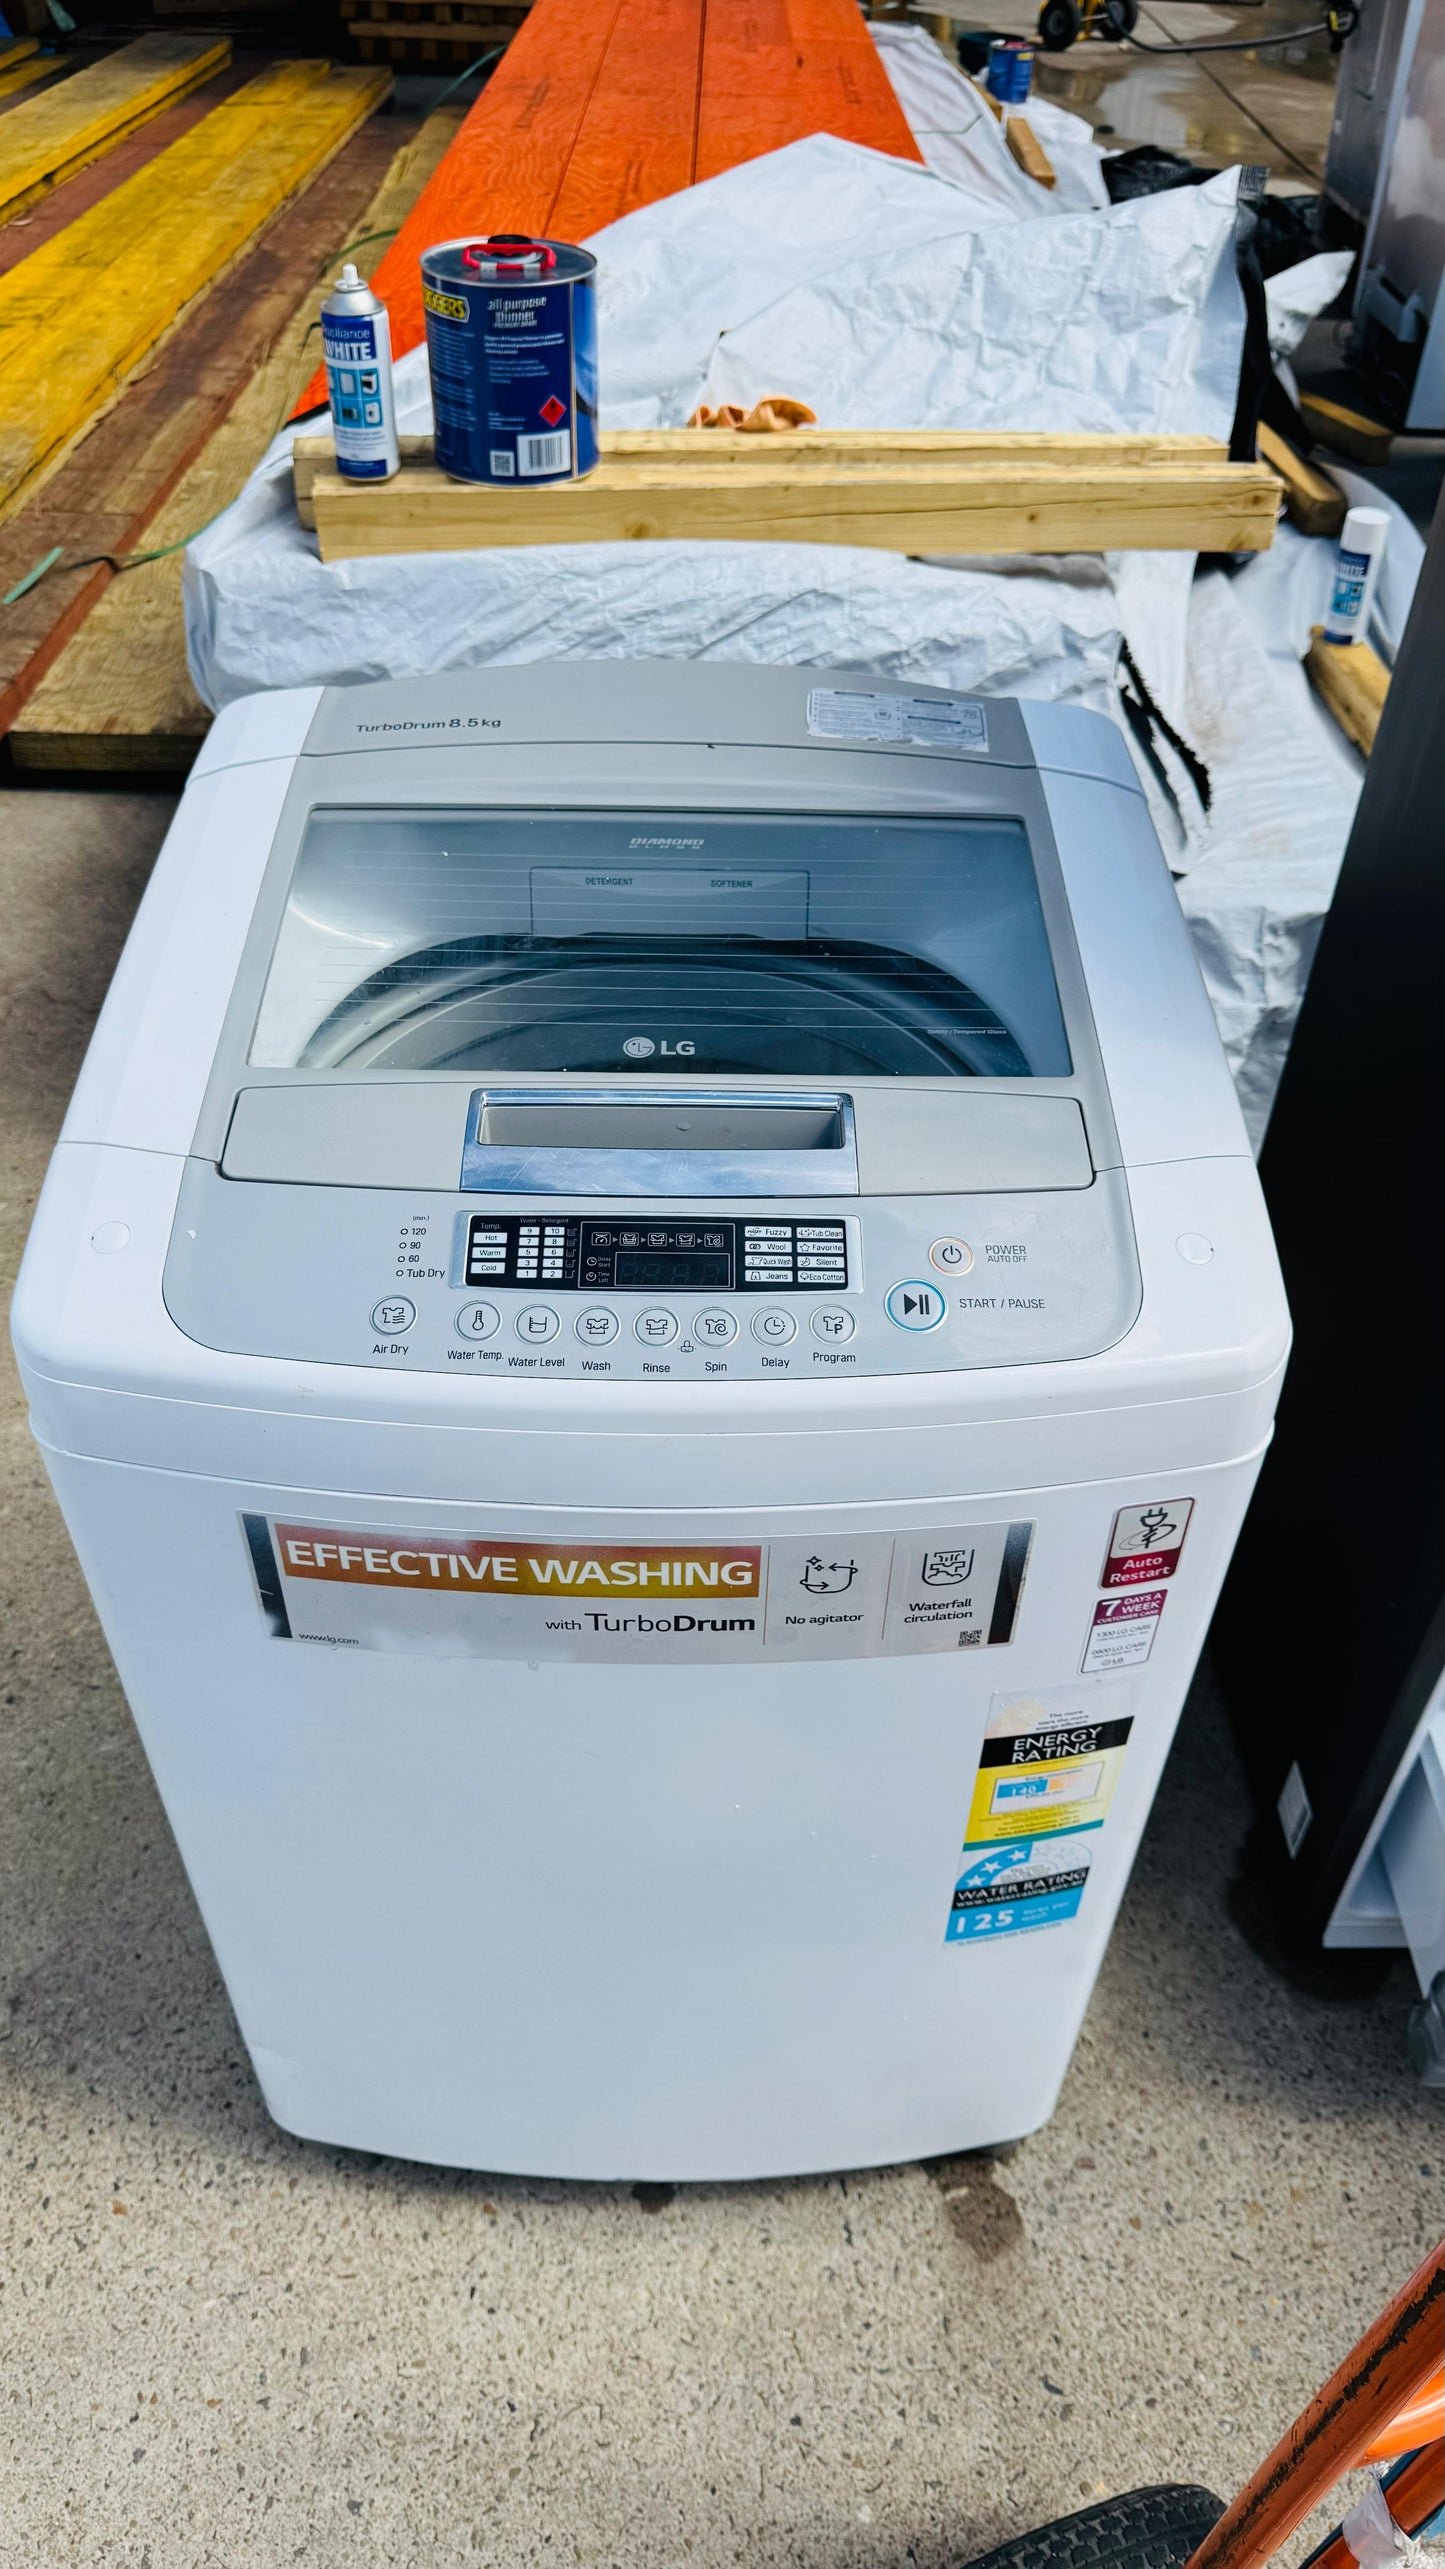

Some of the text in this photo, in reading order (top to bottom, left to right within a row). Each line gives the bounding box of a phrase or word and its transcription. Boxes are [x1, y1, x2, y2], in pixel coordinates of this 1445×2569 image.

[487, 296, 547, 312] all purpose
[325, 339, 373, 360] WHITE
[356, 721, 446, 733] TurboDrum
[630, 838, 704, 846] DIAMOND
[585, 877, 753, 889] DETERGENT SOFTENER
[661, 1041, 696, 1056] LG
[411, 1228, 427, 1236] 120
[480, 1222, 502, 1230] Temp.
[485, 1234, 498, 1242] Hot
[765, 1229, 788, 1237] Fuzzy
[409, 1241, 421, 1250] 90
[767, 1243, 787, 1251] Wool
[812, 1244, 843, 1252] Favorite
[985, 1245, 1027, 1255] POWER
[408, 1255, 420, 1263] 60
[987, 1255, 1028, 1263] AUTO OFF
[407, 1269, 446, 1279] Tub Dry
[481, 1264, 497, 1272] Cold
[959, 1298, 996, 1309] START
[1008, 1298, 1046, 1309] PAUSE
[372, 1344, 409, 1355] Air Dry
[447, 1350, 504, 1362] Water Temp.
[812, 1352, 856, 1365] Program
[508, 1357, 565, 1368] Water Level
[581, 1361, 611, 1371] Wash
[642, 1363, 671, 1373] Rinse
[704, 1362, 728, 1373] Spin
[761, 1357, 790, 1369] Delay
[286, 1540, 753, 1586] EFFECTIVE WASHING
[1123, 1556, 1163, 1570] Auto
[1109, 1566, 1172, 1584] Restart
[908, 1598, 972, 1612] Waterfall
[1101, 1592, 1162, 1617] 7 DAYS A
[1121, 1600, 1161, 1614] WEEK
[545, 1612, 755, 1632] with TurboDrum
[785, 1612, 864, 1626] No agitator
[904, 1610, 973, 1624] circulation
[1096, 1613, 1139, 1624] CUSTOMER
[299, 1633, 359, 1645] www.lg.com
[1013, 1727, 1103, 1751] ENERGY
[1011, 1740, 1097, 1764] RATING
[958, 1884, 1019, 1900] WATER
[1023, 1870, 1086, 1891] RATING
